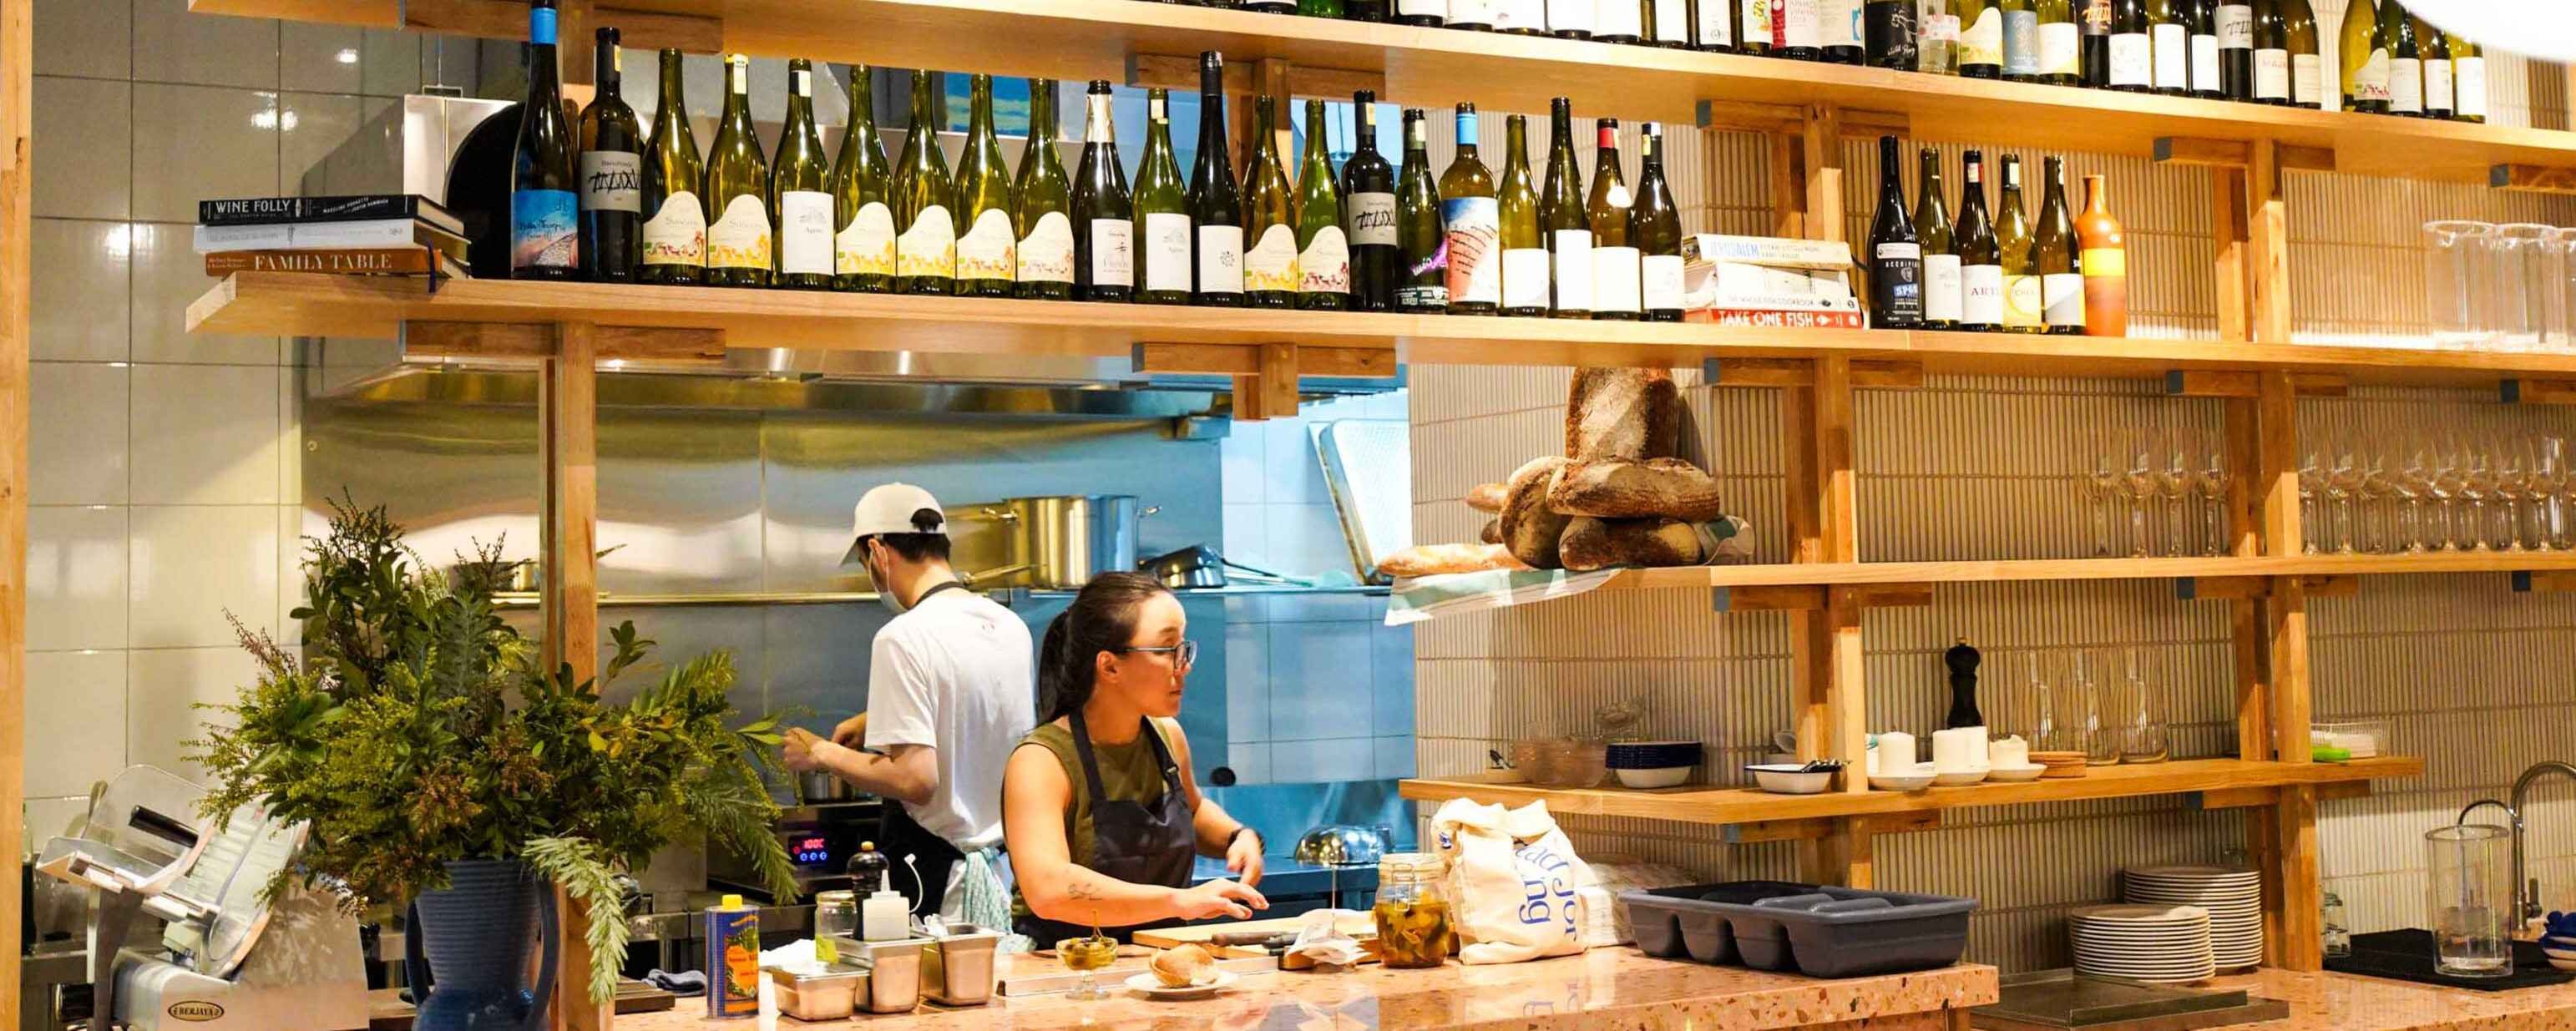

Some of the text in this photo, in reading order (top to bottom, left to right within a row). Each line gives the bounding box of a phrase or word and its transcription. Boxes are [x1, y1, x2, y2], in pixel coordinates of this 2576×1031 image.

[216, 200, 291, 213] WINE FOLLY
[255, 255, 324, 270] FAMILY
[330, 253, 392, 269] TABLE
[1719, 311, 1814, 327] TAKE ONE FISH
